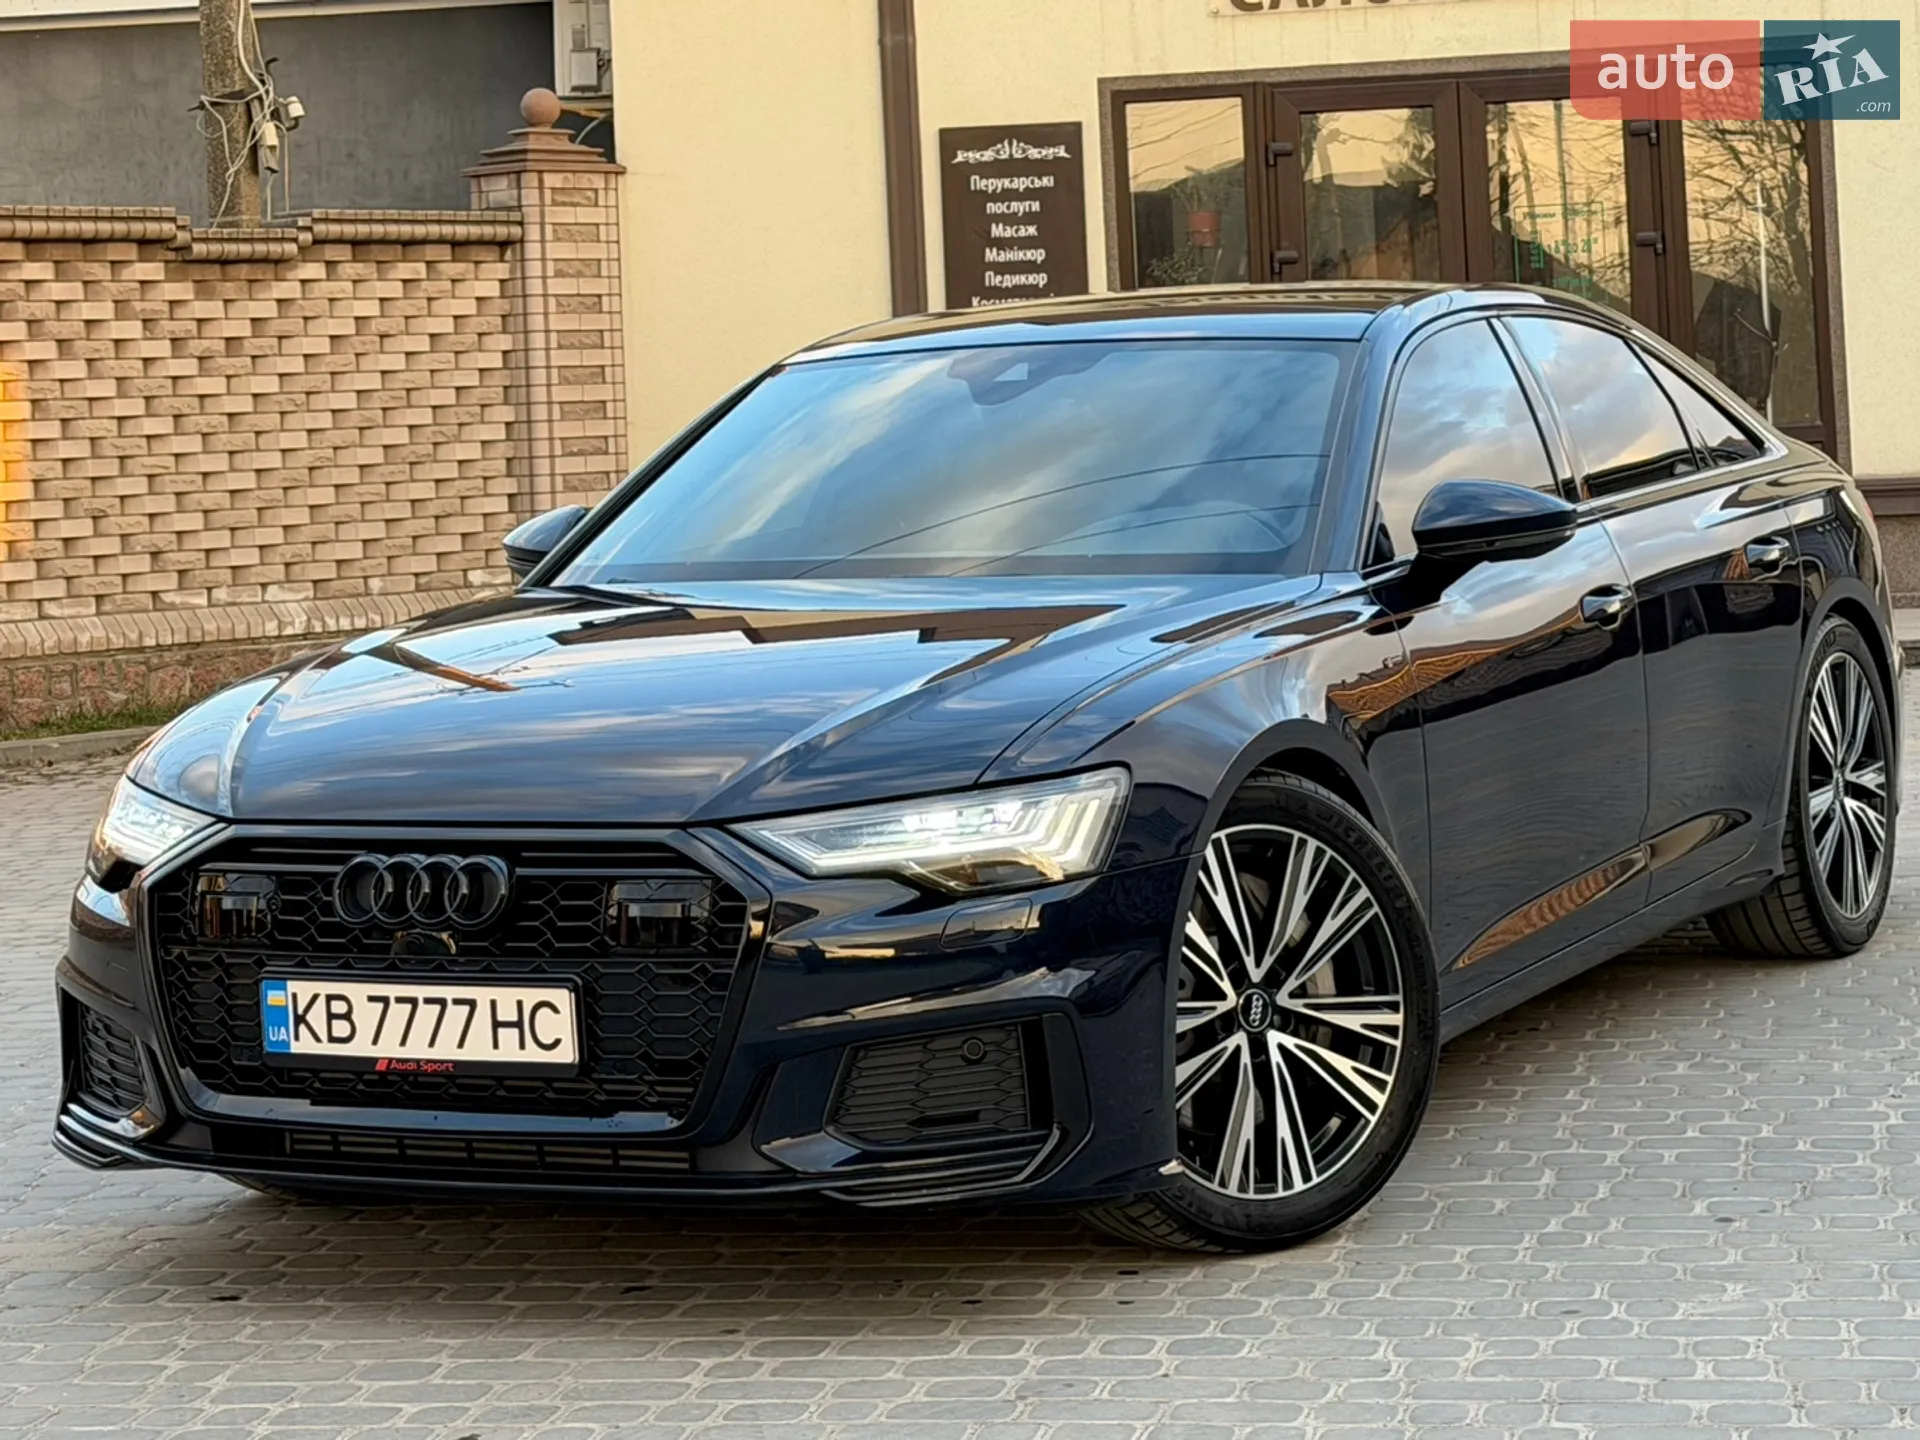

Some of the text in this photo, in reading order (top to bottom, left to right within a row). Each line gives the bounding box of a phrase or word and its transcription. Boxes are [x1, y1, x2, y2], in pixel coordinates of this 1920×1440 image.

[970, 174, 1055, 194] Перукарські
[986, 200, 1041, 217] послуги
[990, 222, 1038, 239] Масаж
[984, 246, 1046, 264] Манікюр
[984, 270, 1048, 288] Педикюр
[291, 991, 563, 1051] KB 7777 HC
[268, 1025, 288, 1042] UA
[390, 1059, 455, 1073] Audi Sport
